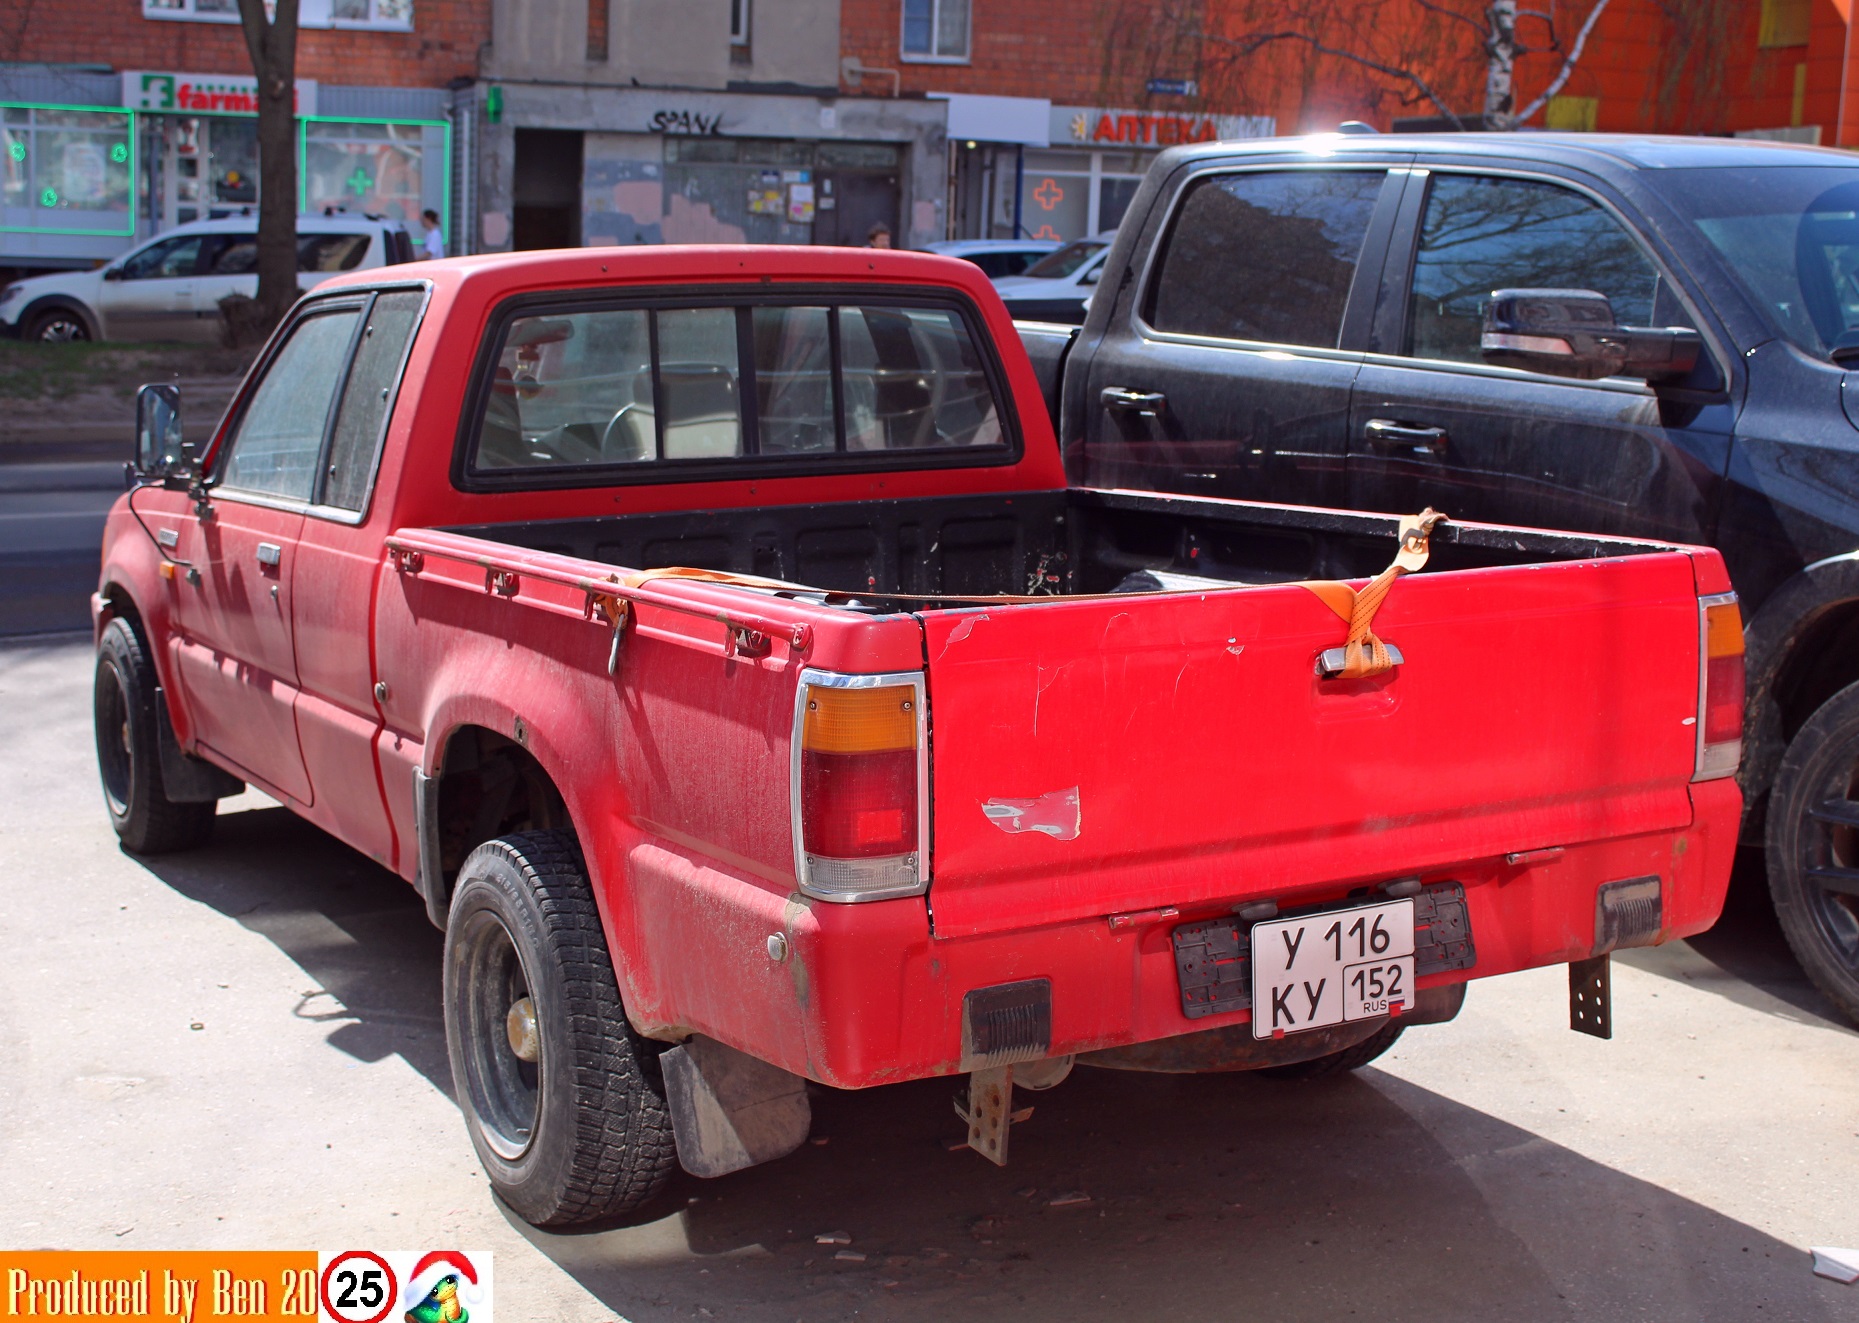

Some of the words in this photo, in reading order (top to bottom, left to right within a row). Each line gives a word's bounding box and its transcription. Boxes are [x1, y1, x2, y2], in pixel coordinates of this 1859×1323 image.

[1093, 113, 1217, 144] АПТЕКА
[1324, 914, 1391, 961] 116
[1351, 965, 1403, 1000] 152
[1363, 999, 1388, 1013] RUS
